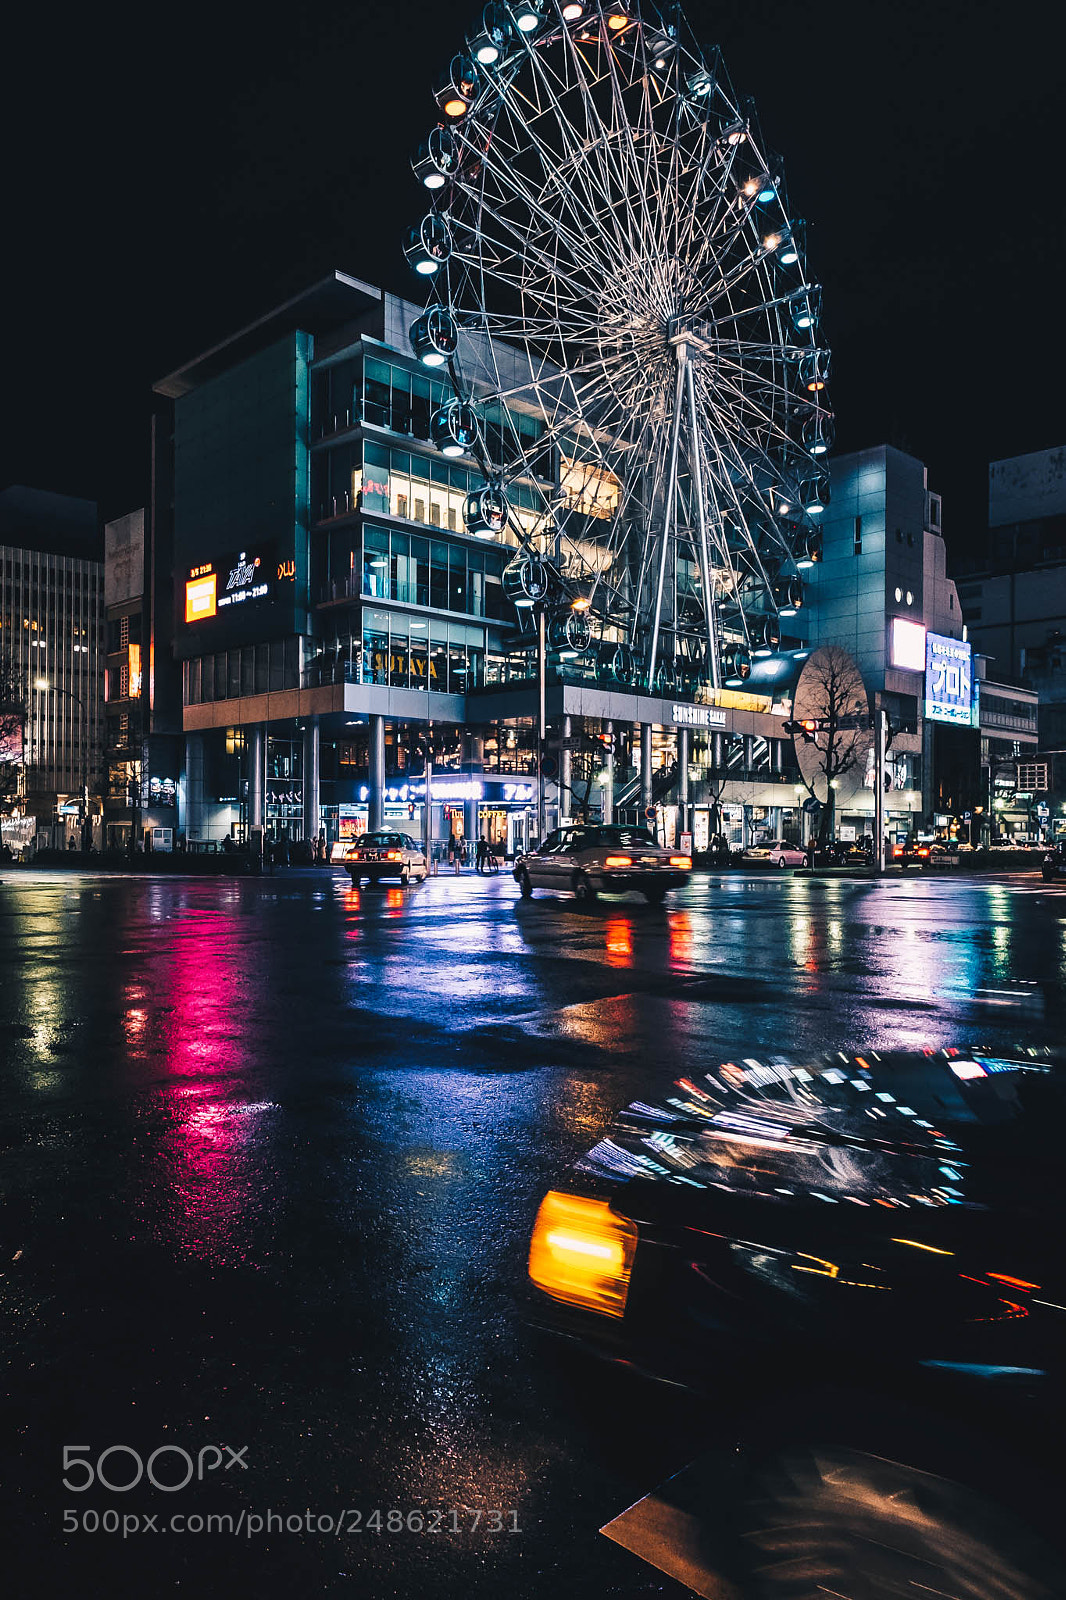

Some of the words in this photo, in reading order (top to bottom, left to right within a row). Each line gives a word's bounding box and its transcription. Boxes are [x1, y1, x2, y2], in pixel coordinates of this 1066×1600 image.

[930, 659, 970, 700] プロト
[672, 704, 709, 726] SUNSHINE
[450, 808, 464, 819] TUL
[477, 810, 507, 819] COFFEE
